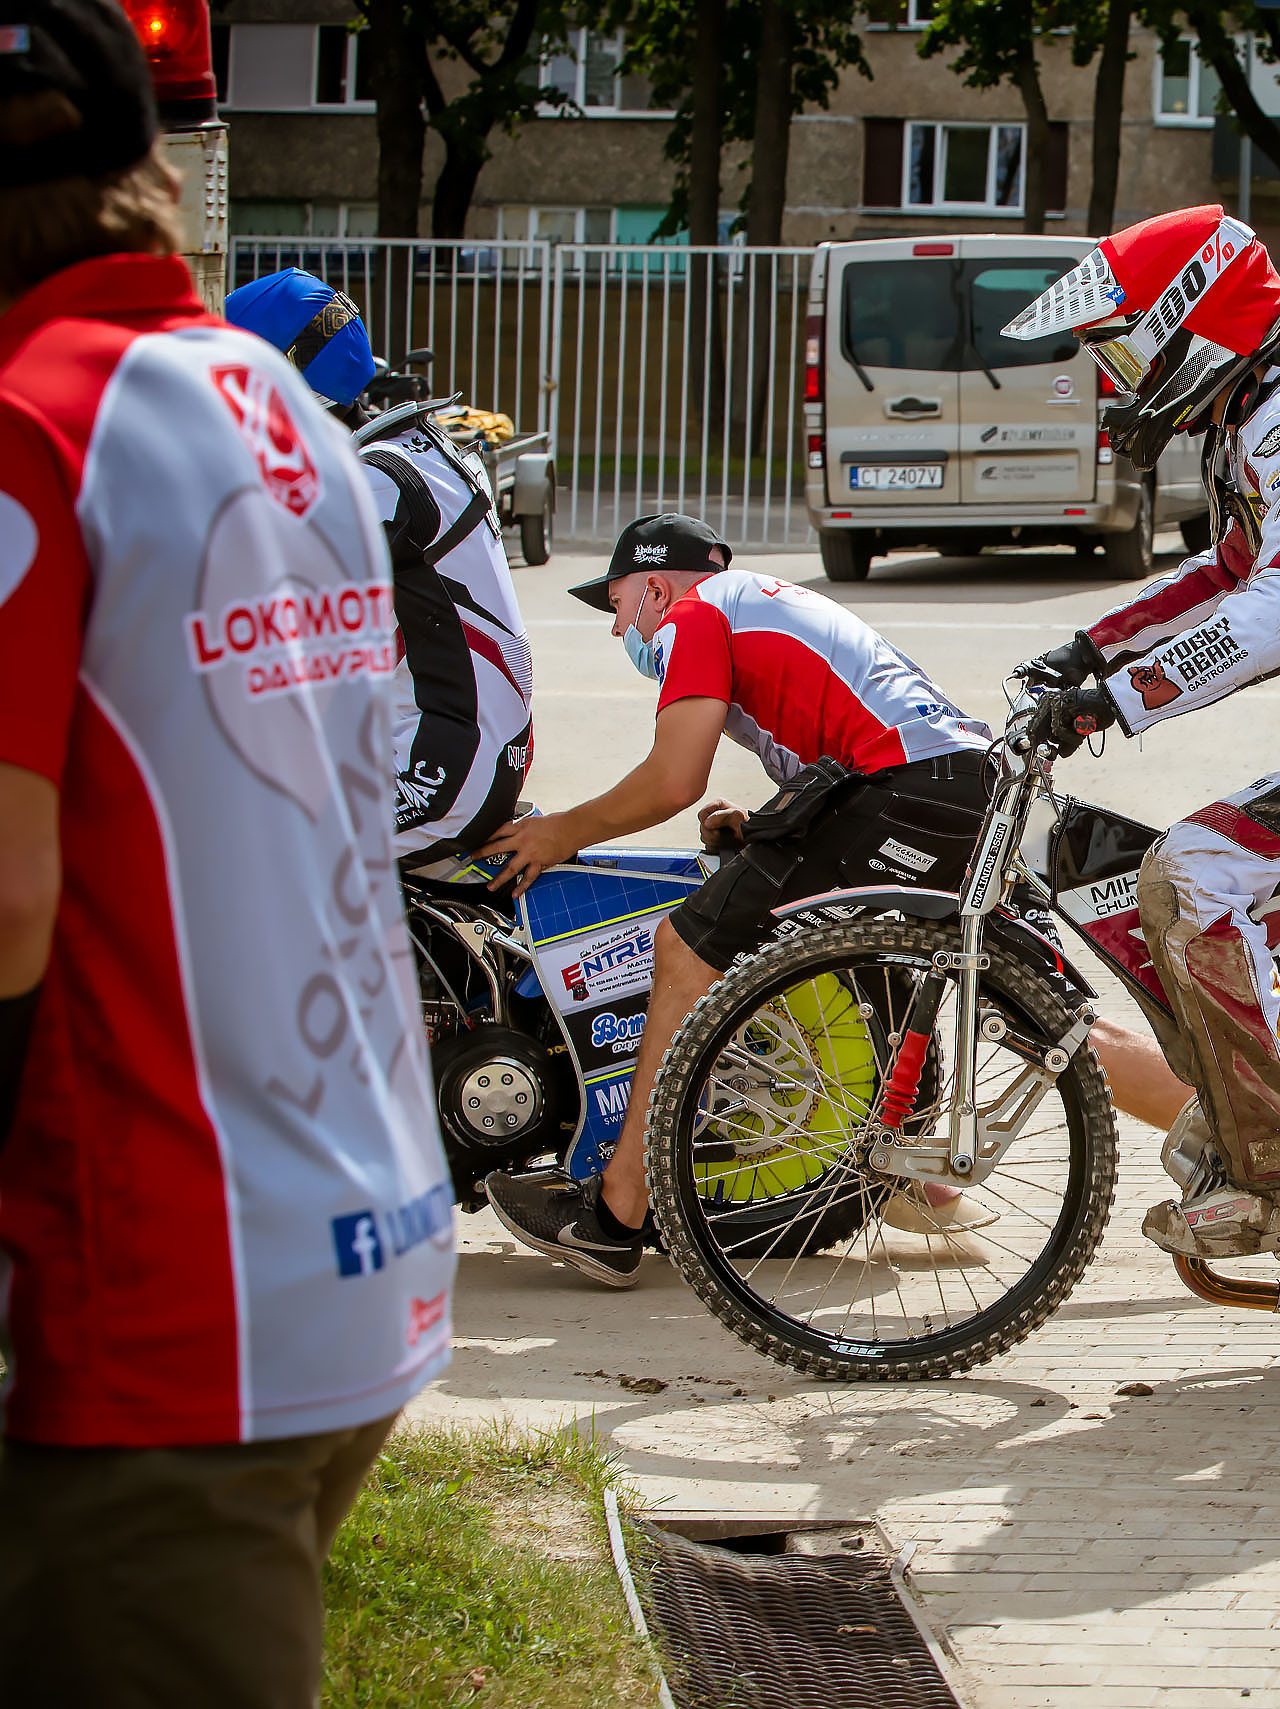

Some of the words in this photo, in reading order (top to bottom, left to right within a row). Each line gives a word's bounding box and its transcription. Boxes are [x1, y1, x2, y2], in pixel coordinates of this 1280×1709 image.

[861, 468, 880, 485] CT
[888, 468, 938, 485] 2407V
[1161, 616, 1231, 667] YOGGY
[1176, 634, 1240, 683] BEAR
[1090, 873, 1140, 904] MIH
